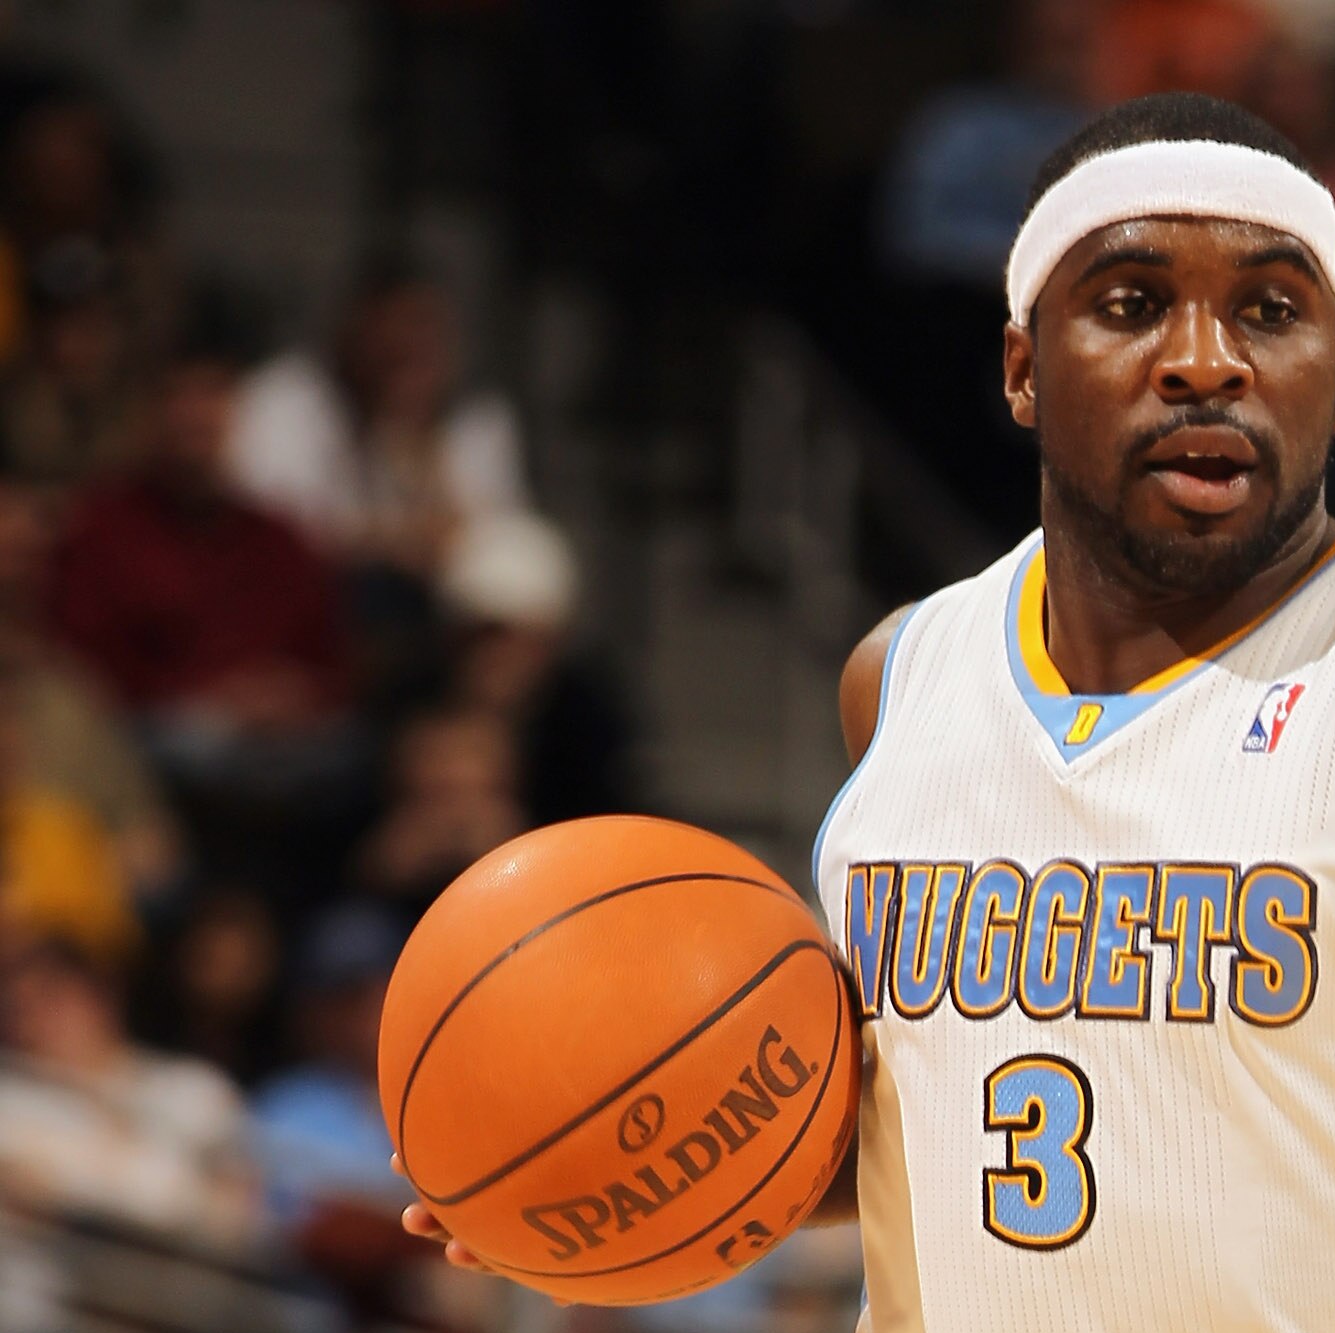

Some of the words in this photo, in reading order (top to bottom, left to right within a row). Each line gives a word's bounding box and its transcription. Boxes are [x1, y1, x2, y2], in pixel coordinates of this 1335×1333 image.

[845, 858, 1318, 1028] NUGGETS
[520, 1023, 811, 1262] SPALDING
[982, 1052, 1097, 1251] 3
